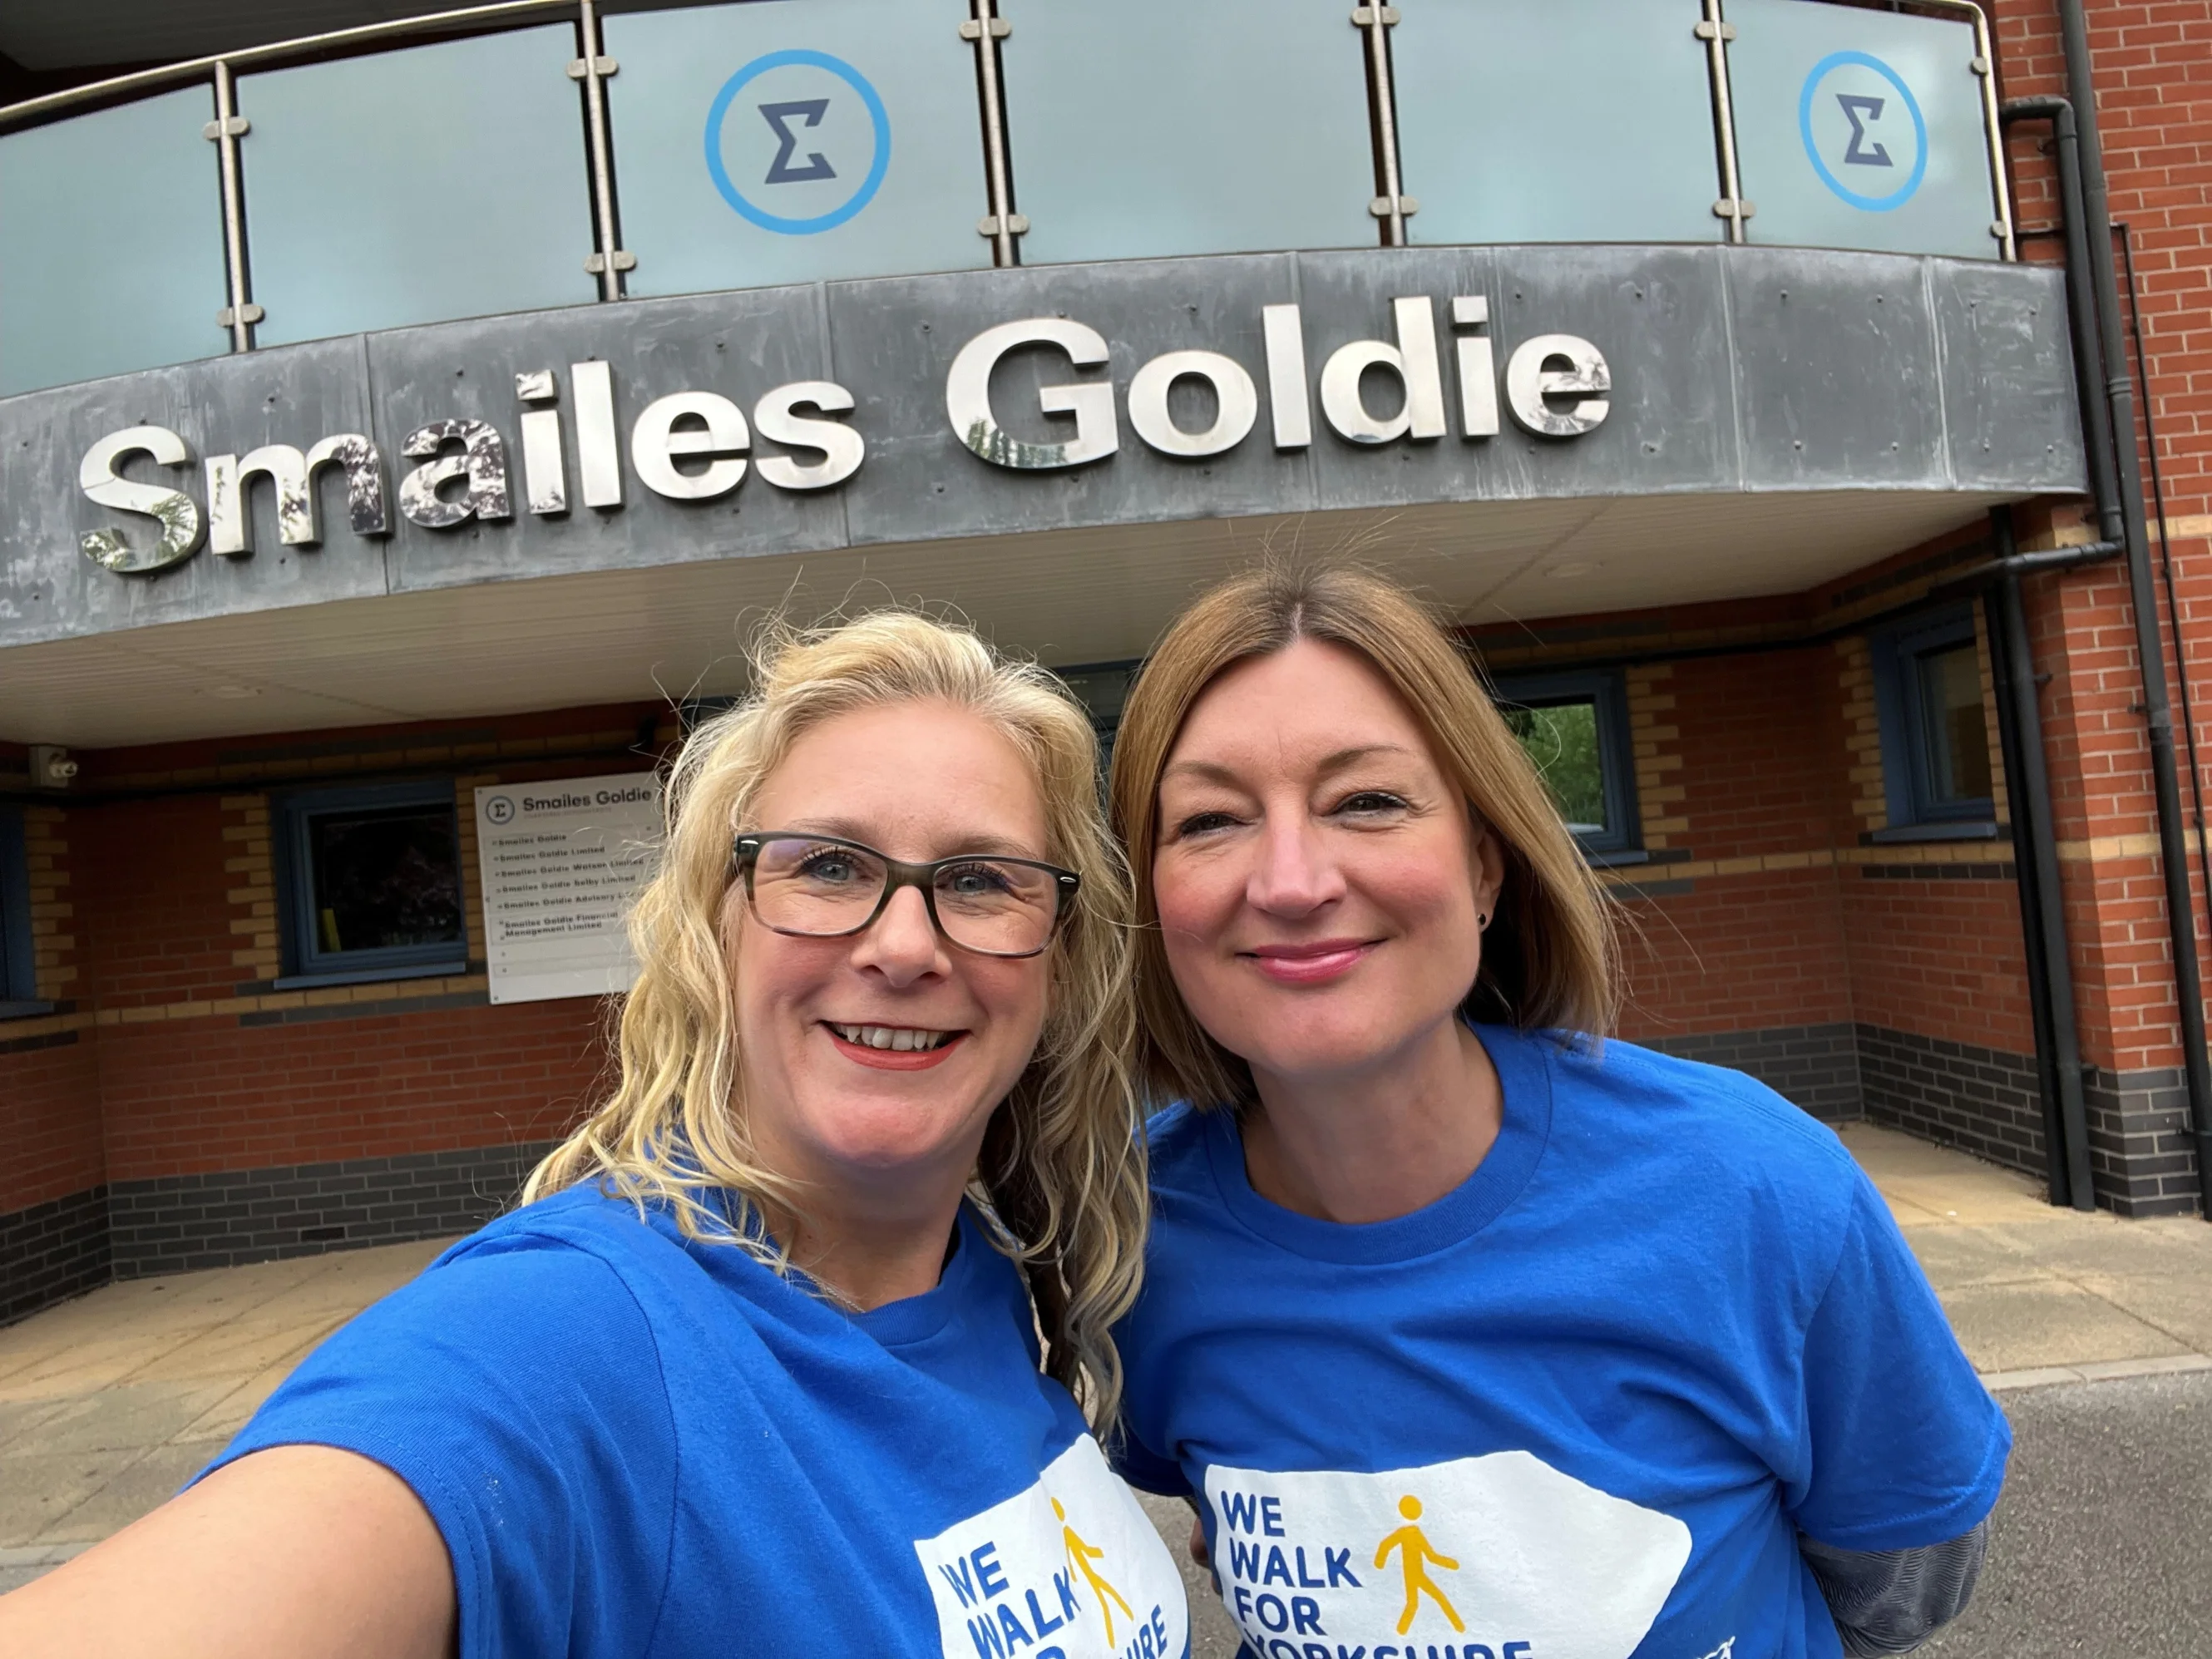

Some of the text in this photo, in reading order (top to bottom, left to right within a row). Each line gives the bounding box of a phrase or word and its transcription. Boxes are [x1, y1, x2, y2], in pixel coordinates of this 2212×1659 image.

[79, 294, 1612, 574] Smailes Goldie
[523, 787, 652, 812] Smailes Goldie
[499, 834, 567, 846] Smailes Goldie
[500, 852, 536, 862] Smailes
[539, 849, 569, 859] Goldie
[1221, 1490, 1286, 1538] WE
[938, 1540, 1010, 1609] WE
[1229, 1537, 1364, 1588] WALK
[967, 1566, 1082, 1659] WALK
[1234, 1586, 1328, 1637] FOR
